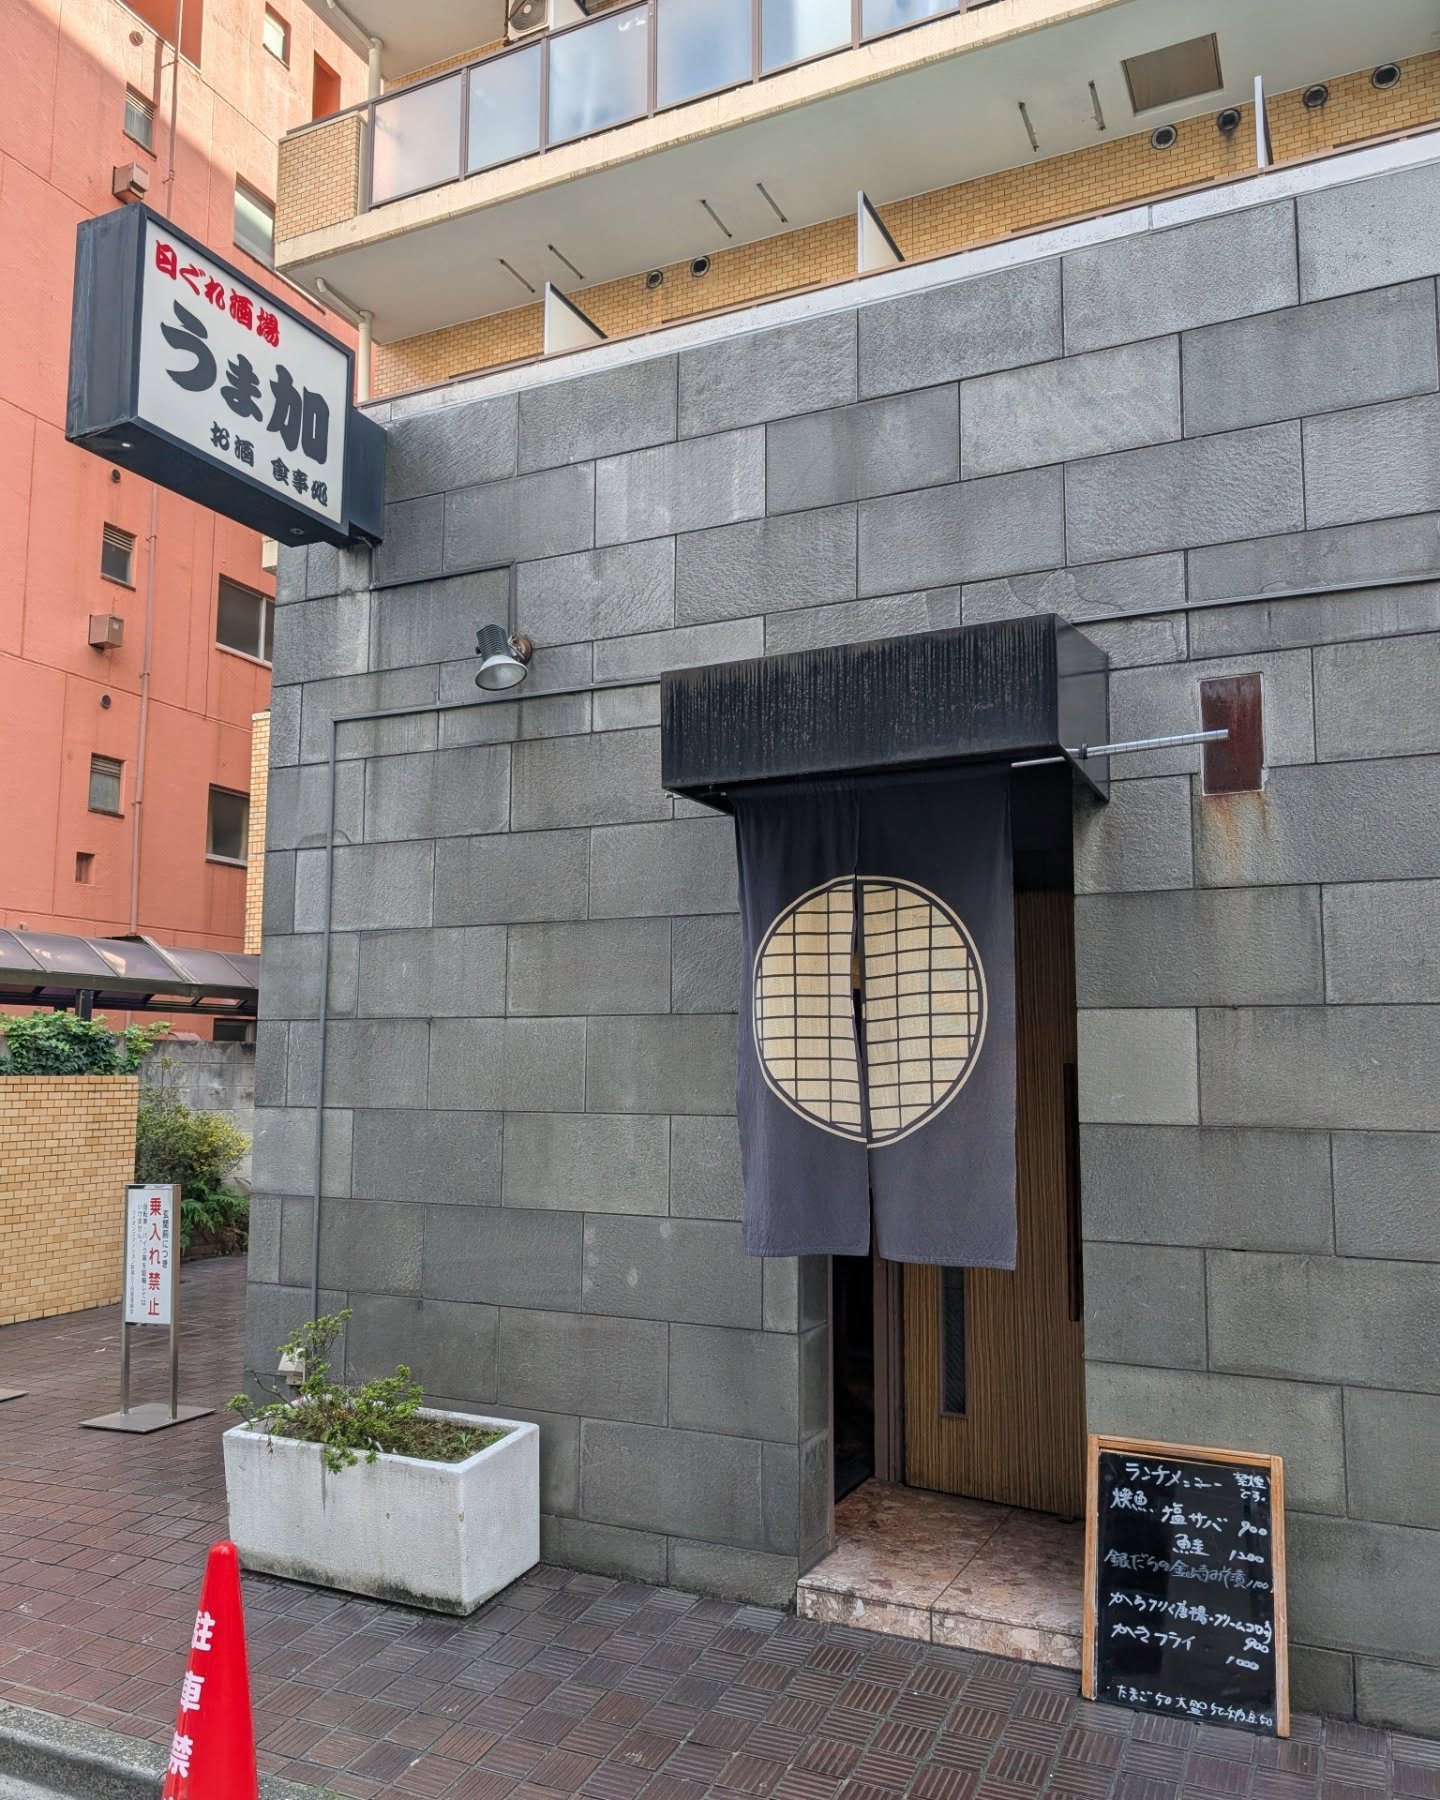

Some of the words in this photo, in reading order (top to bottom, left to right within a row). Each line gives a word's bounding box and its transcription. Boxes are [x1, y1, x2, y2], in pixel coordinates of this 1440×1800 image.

[160, 299, 330, 464] うま加
[209, 421, 255, 467] お酒
[147, 1197, 162, 1316] 乗入れ禁止
[1125, 1462, 1222, 1488] ランチメニュー
[1161, 1502, 1228, 1532] 塩サバ
[1238, 1520, 1268, 1537] 900
[1172, 1533, 1210, 1556] 鮭
[1228, 1549, 1265, 1564] 1200
[1226, 1655, 1260, 1671] 1000
[1243, 1638, 1270, 1654] 900
[163, 1610, 216, 1800] 駐車禁
